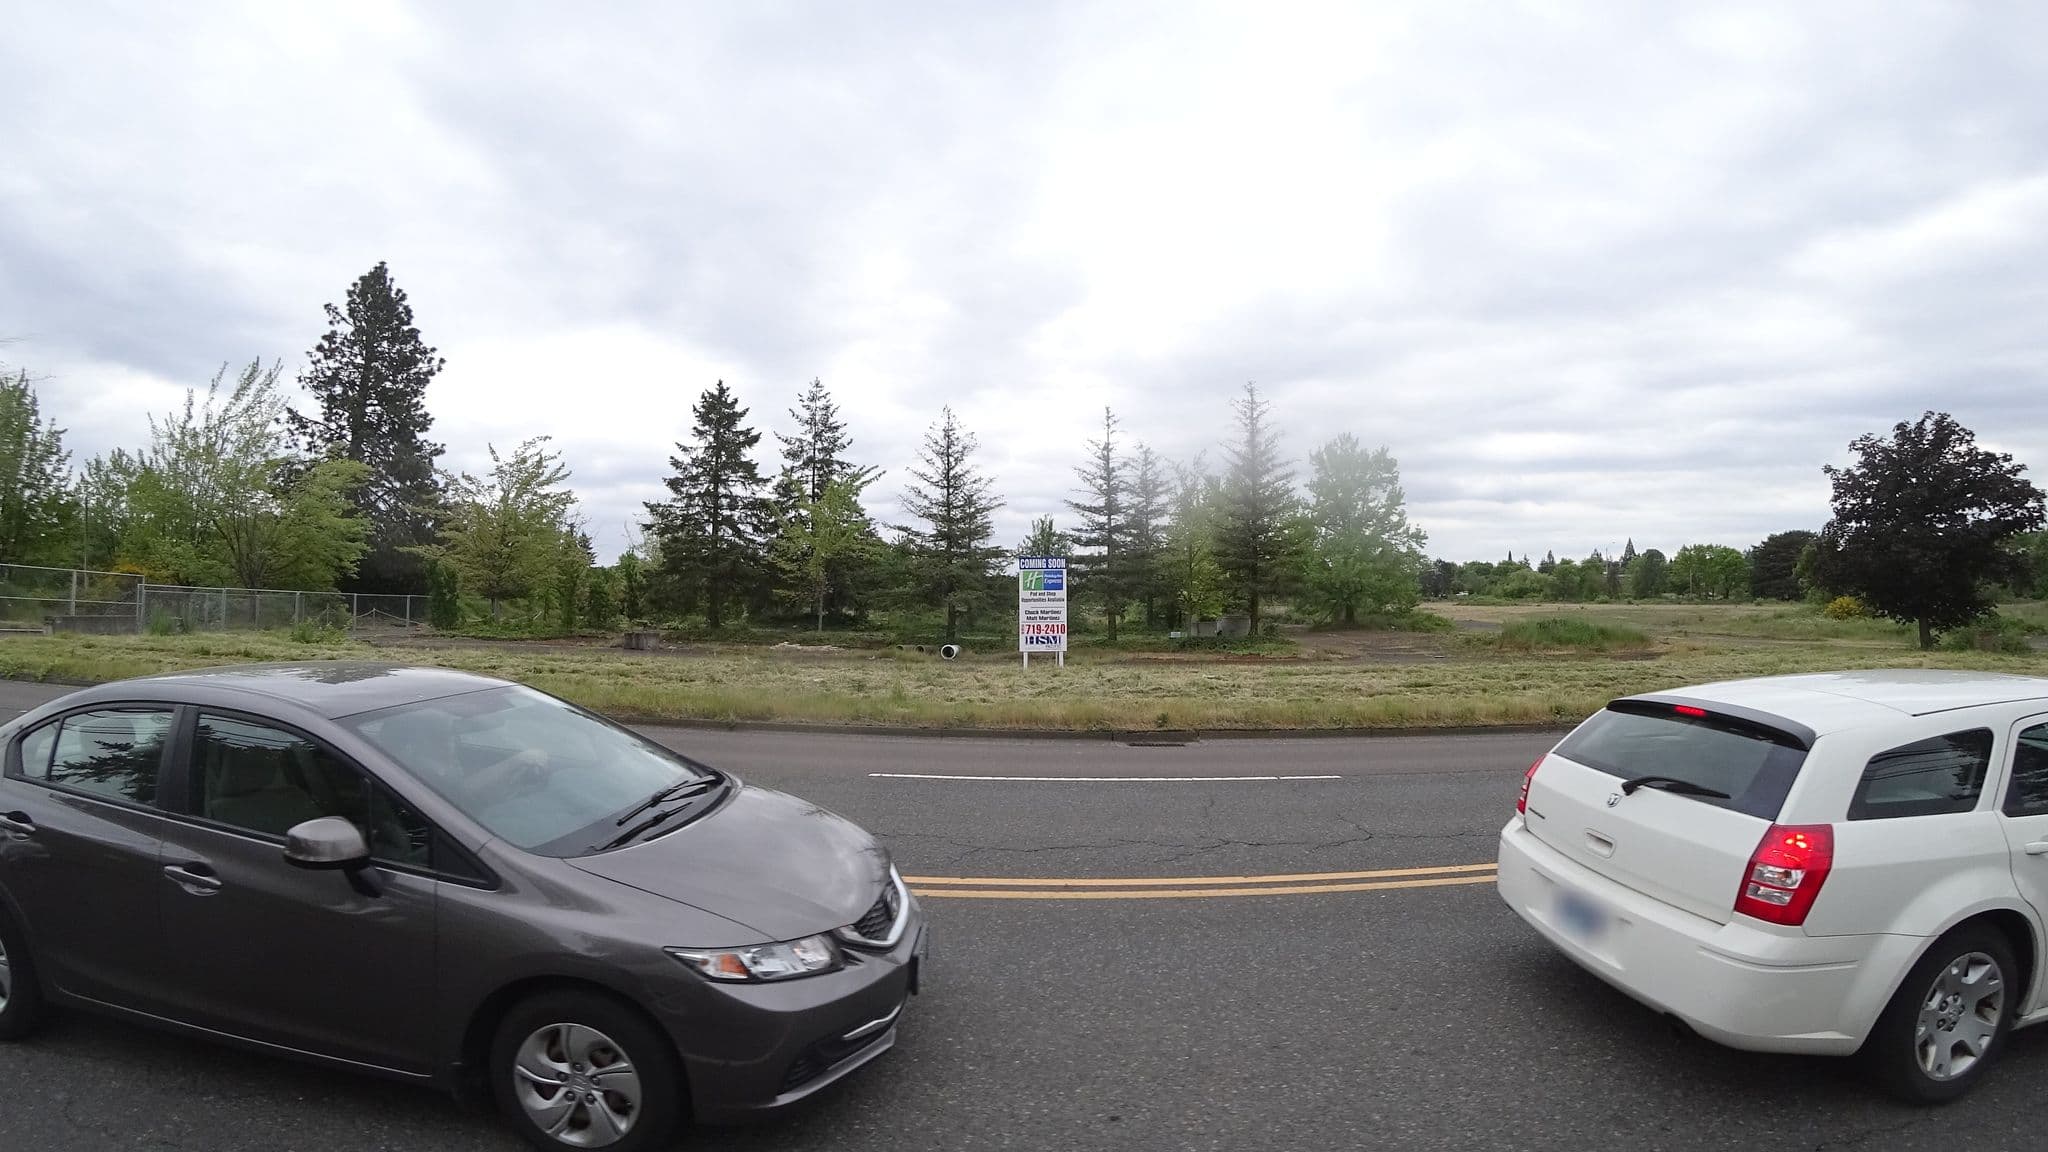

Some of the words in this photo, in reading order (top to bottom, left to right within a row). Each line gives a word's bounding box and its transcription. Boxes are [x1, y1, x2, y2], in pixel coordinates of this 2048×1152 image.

[1020, 558, 1046, 569] COMING
[1048, 558, 1066, 569] SOON
[1025, 623, 1066, 635] 719-2410
[1025, 636, 1061, 645] HSM
